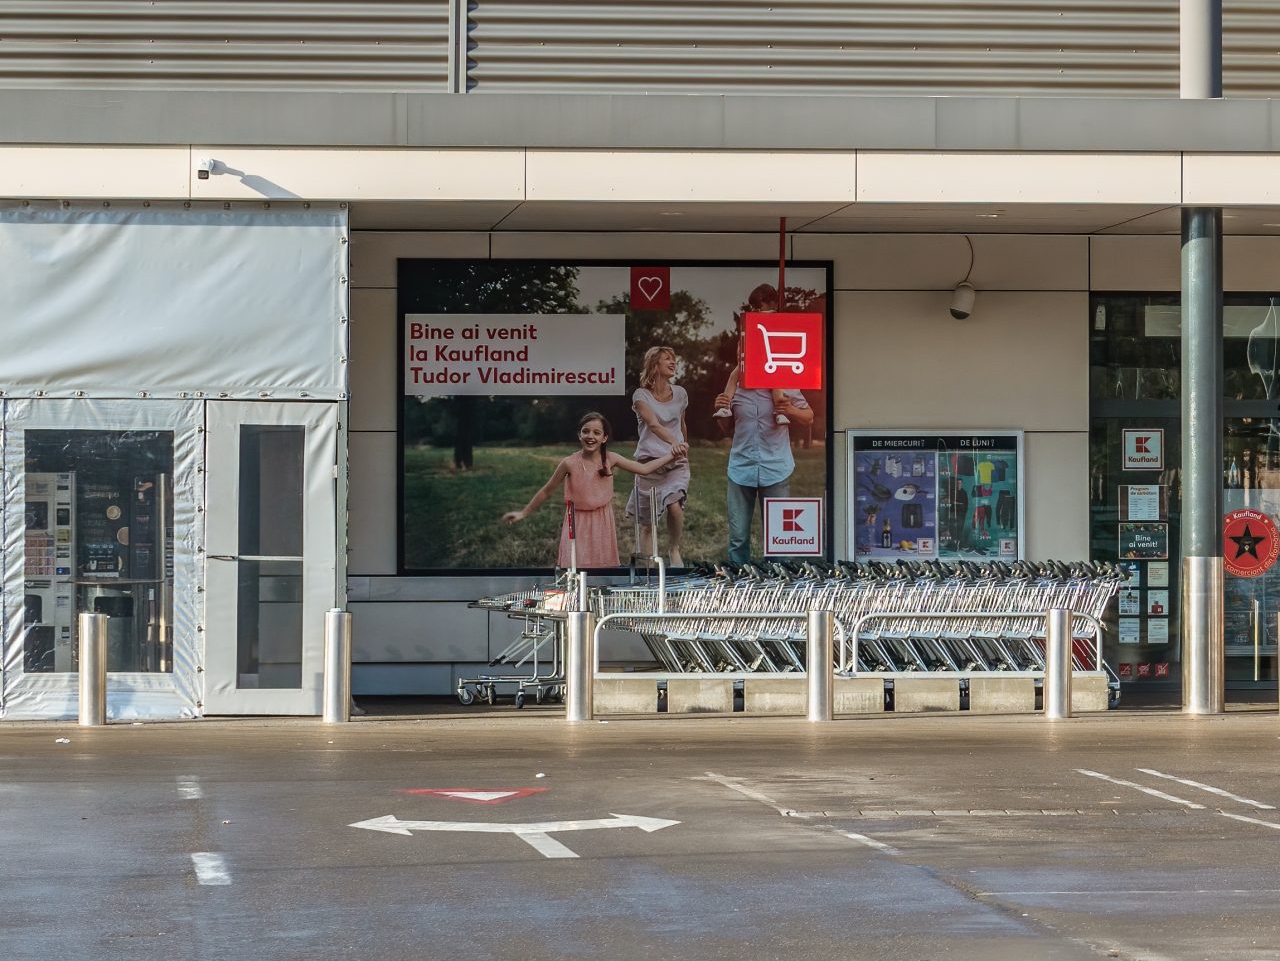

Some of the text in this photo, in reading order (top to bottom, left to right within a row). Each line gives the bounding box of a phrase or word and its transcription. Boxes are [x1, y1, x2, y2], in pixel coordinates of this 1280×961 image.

[410, 323, 538, 340] Bine ai venit
[410, 345, 529, 362] la Kaufland
[410, 367, 616, 384] Tudor Vladimirescu!
[1233, 510, 1262, 520] Kaufland
[772, 536, 815, 545] Kaufland
[1226, 564, 1264, 576] comerciant
